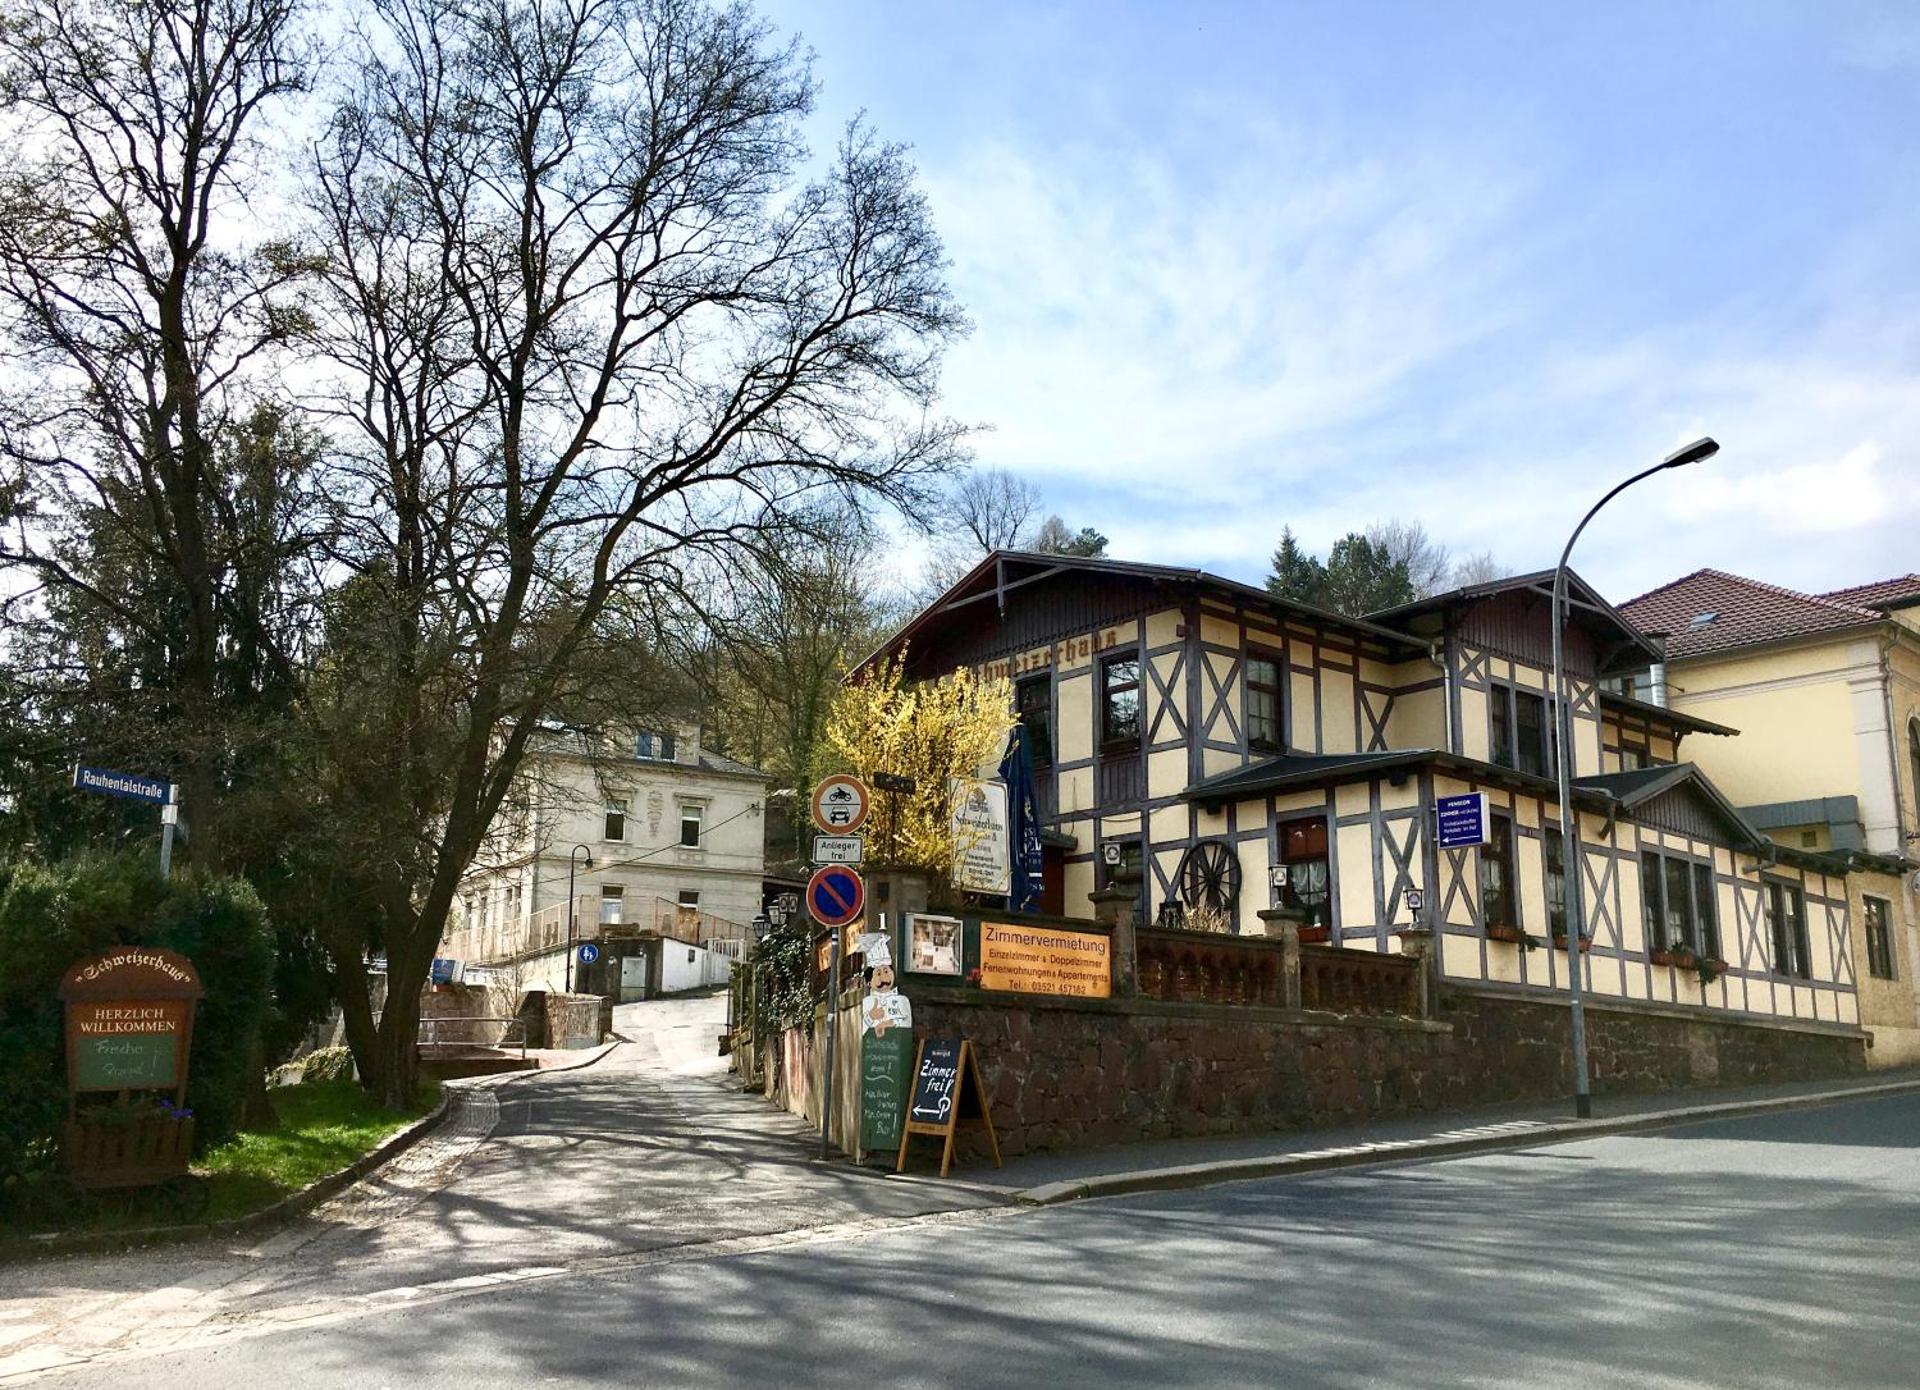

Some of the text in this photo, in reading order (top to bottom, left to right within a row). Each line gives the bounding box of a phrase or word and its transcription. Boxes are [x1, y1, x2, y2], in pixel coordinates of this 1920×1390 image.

[83, 770, 162, 798] Rauhentalstraße
[821, 841, 855, 851] Anlieger
[831, 851, 846, 860] frei
[878, 912, 887, 930] 1
[986, 927, 1106, 955] Zimmervermietung
[988, 949, 1040, 961] Einzelzimmer
[1050, 955, 1103, 968] Doppelzimmer
[983, 962, 1053, 978] Ferienwohnungen
[1057, 969, 1108, 983] Appartements
[1031, 981, 1056, 992] 03521
[95, 1008, 164, 1020] HERZLICH
[80, 1021, 176, 1033] WILLKOMMEN
[920, 1059, 958, 1078] Zimmer
